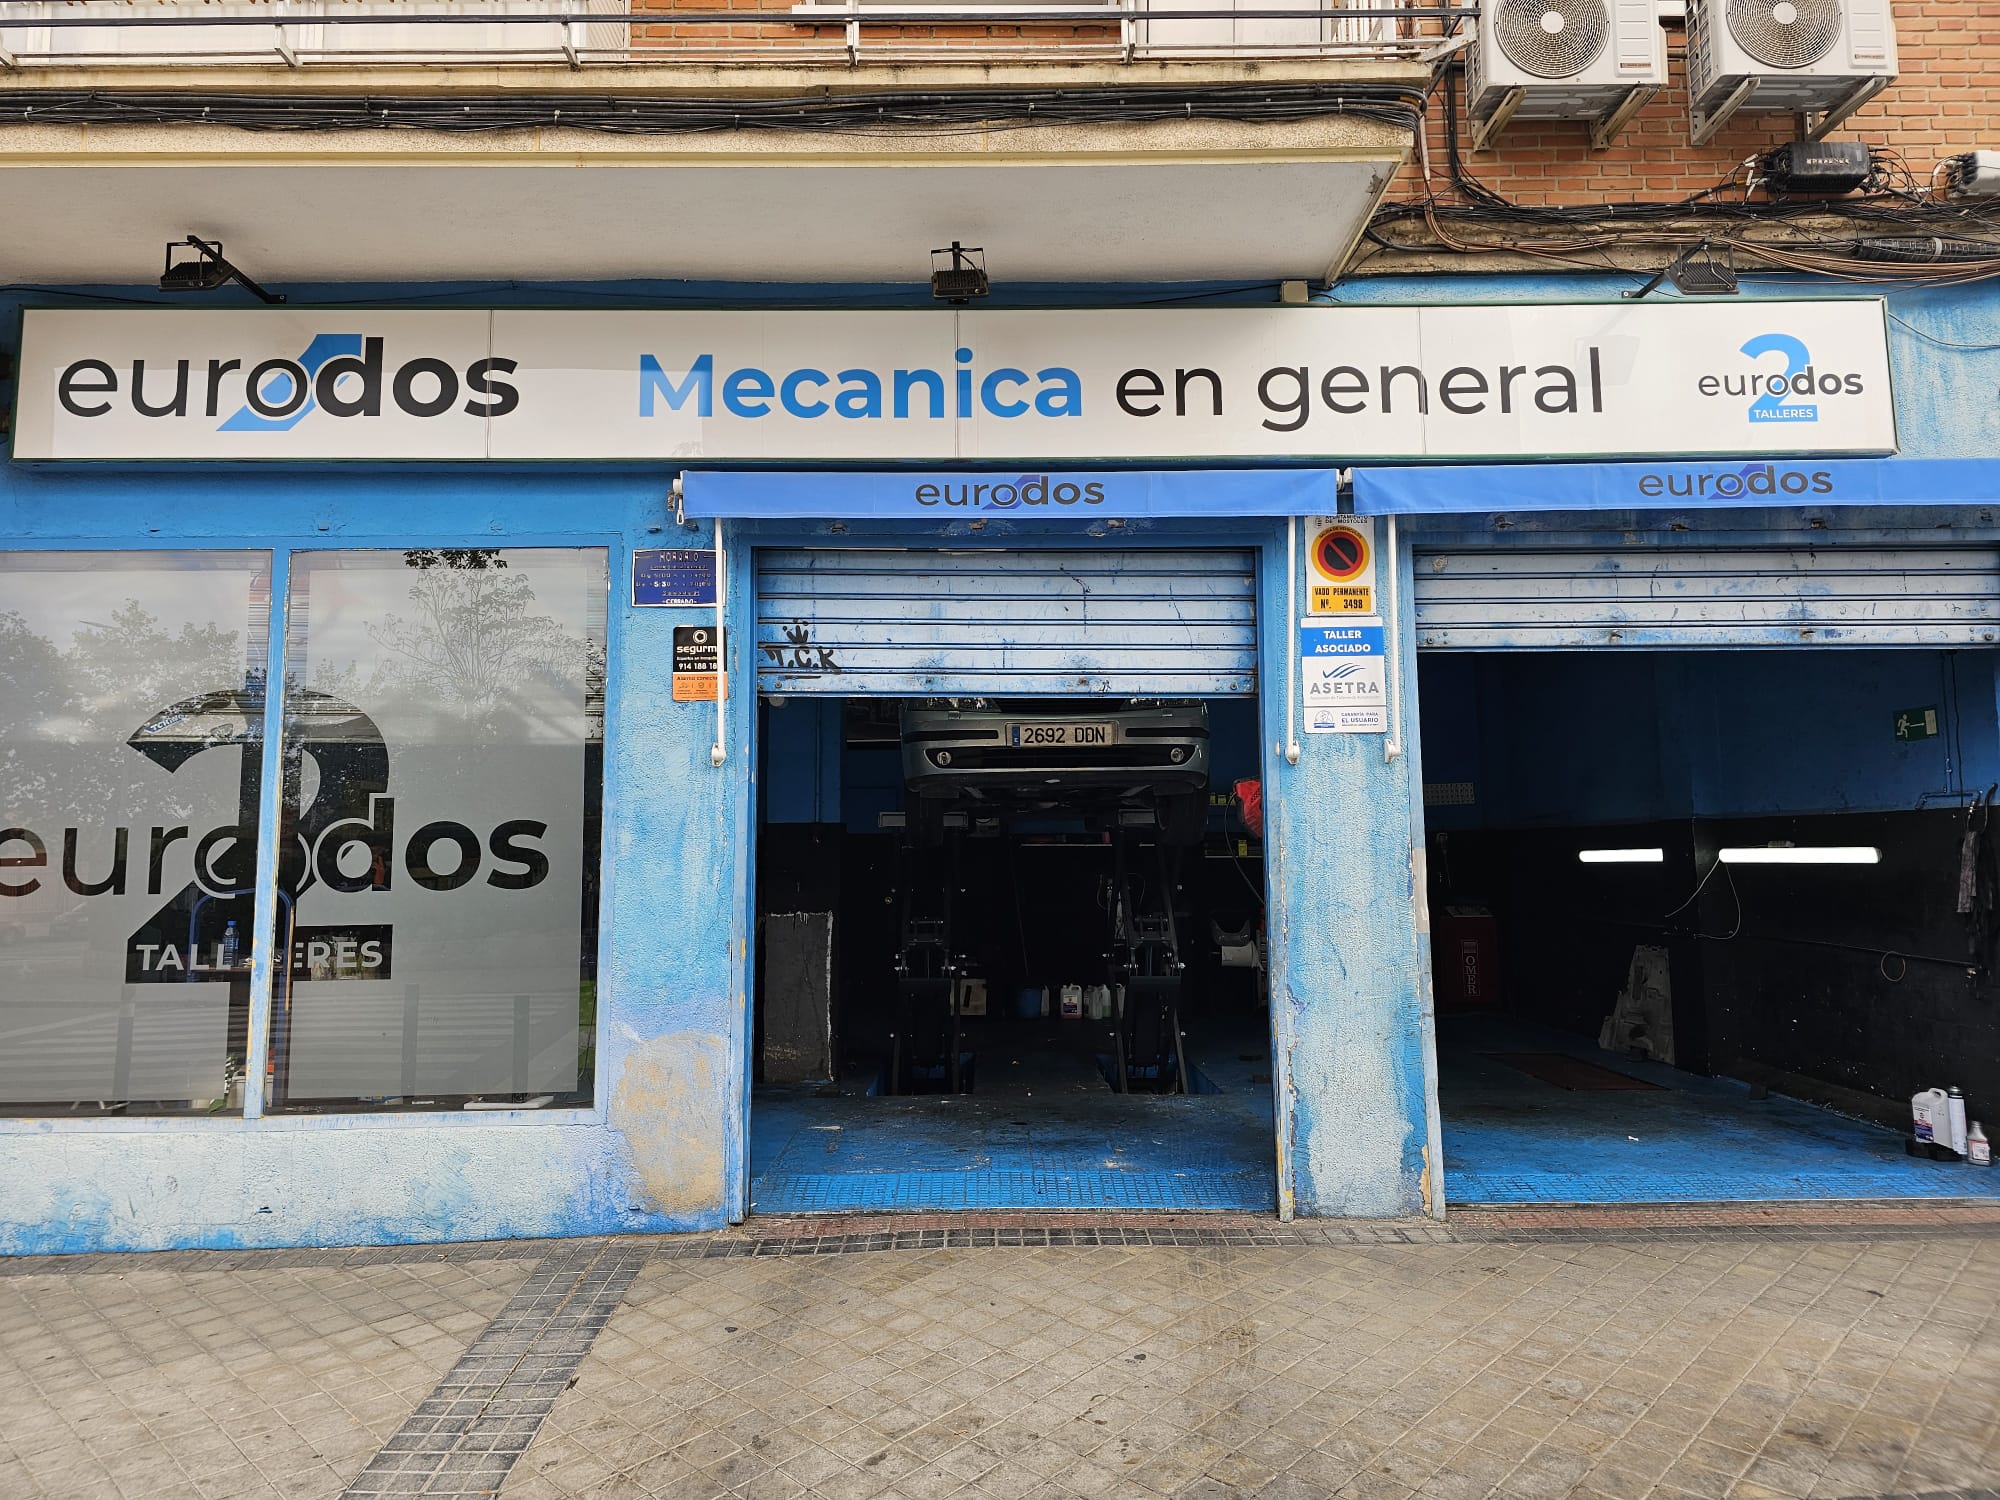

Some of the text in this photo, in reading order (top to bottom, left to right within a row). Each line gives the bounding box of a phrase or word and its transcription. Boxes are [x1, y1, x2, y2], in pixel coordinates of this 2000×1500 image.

[59, 337, 519, 417] eurodos
[1698, 366, 1864, 396] eurodos
[639, 347, 1602, 432] Mecanica en general
[1753, 408, 1814, 419] TALLERES
[1638, 465, 1833, 497] eurodos
[915, 476, 1105, 506] eurodos
[1314, 587, 1369, 596] VADO PERMANENTE
[1343, 599, 1363, 609] 3498
[1323, 630, 1362, 639] TALLER
[676, 645, 717, 655] segurm
[1315, 644, 1371, 653] ASOCIADO
[1310, 682, 1380, 694] ASETRA
[1024, 727, 1105, 743] 2692 DDN
[1464, 955, 1478, 994] OMER
